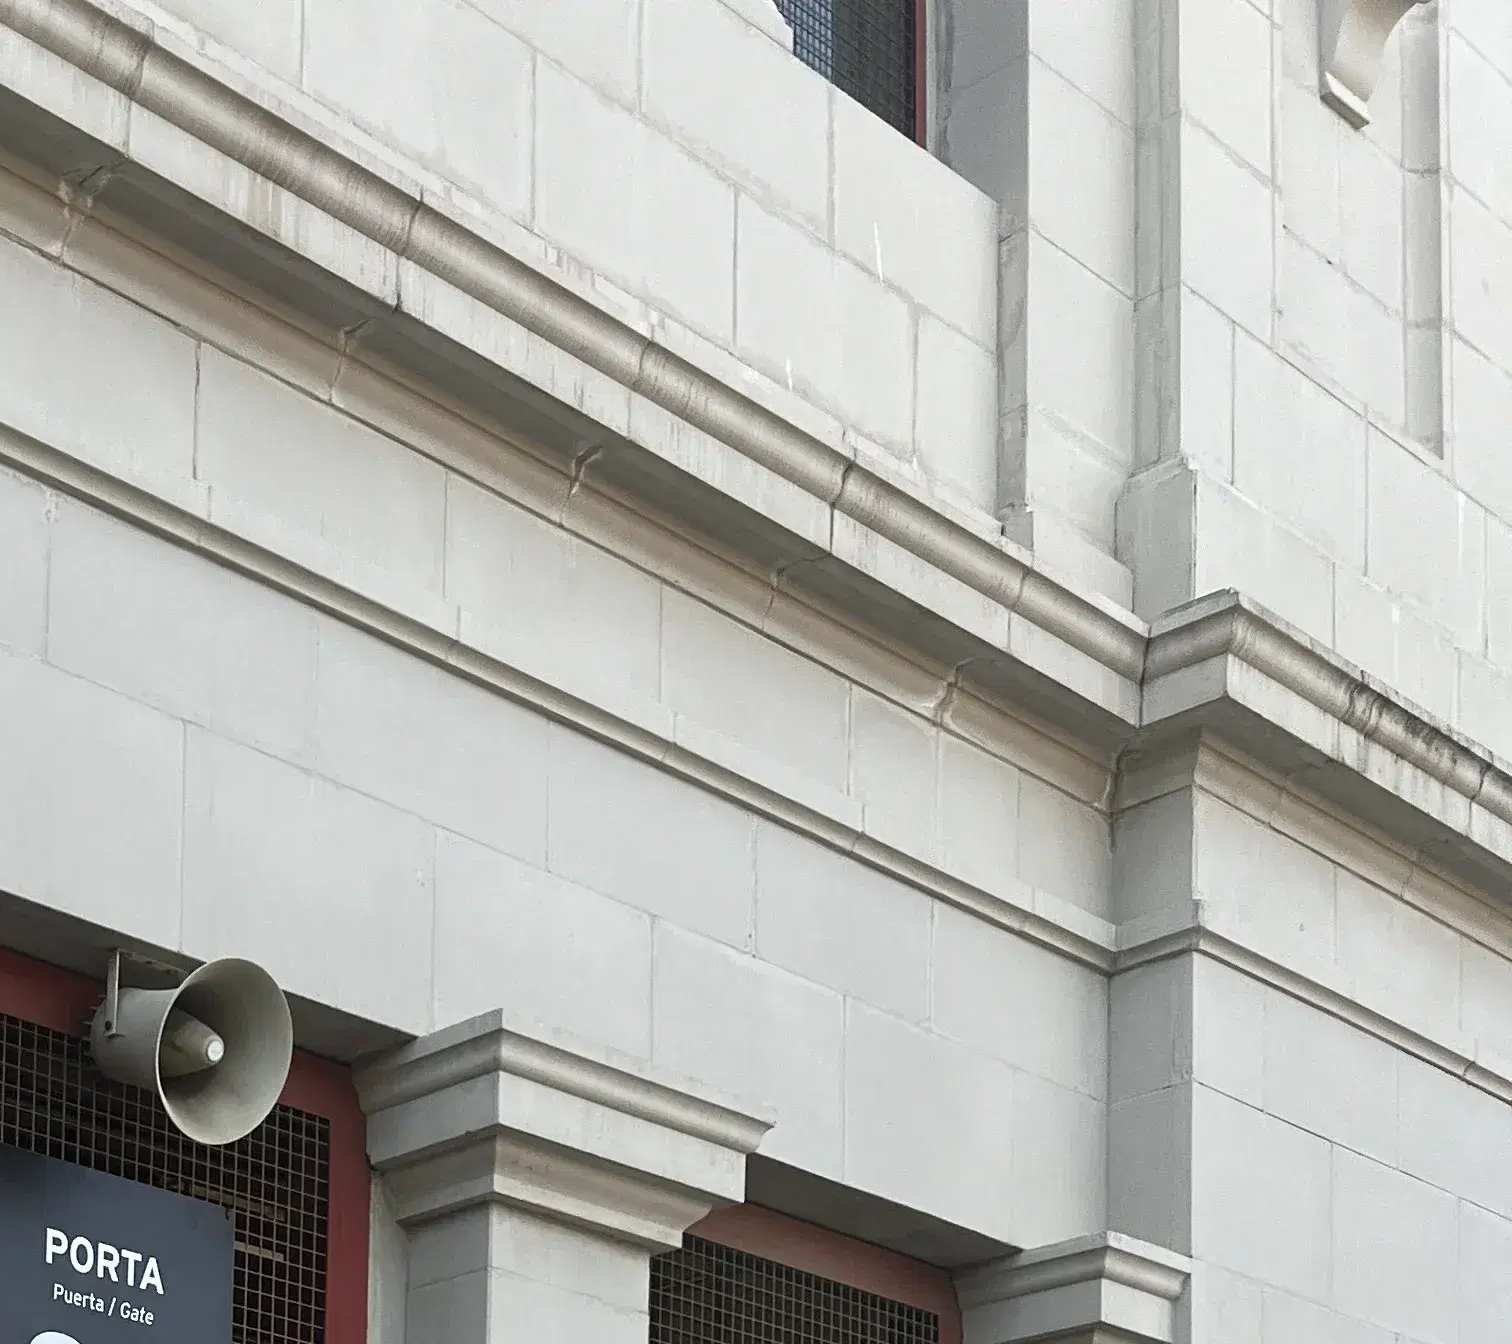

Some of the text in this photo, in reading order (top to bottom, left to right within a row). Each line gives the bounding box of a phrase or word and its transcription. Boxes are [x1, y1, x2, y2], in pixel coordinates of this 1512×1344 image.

[45, 1227, 165, 1295] PORTA
[53, 1282, 154, 1326] Puerta / Gate
